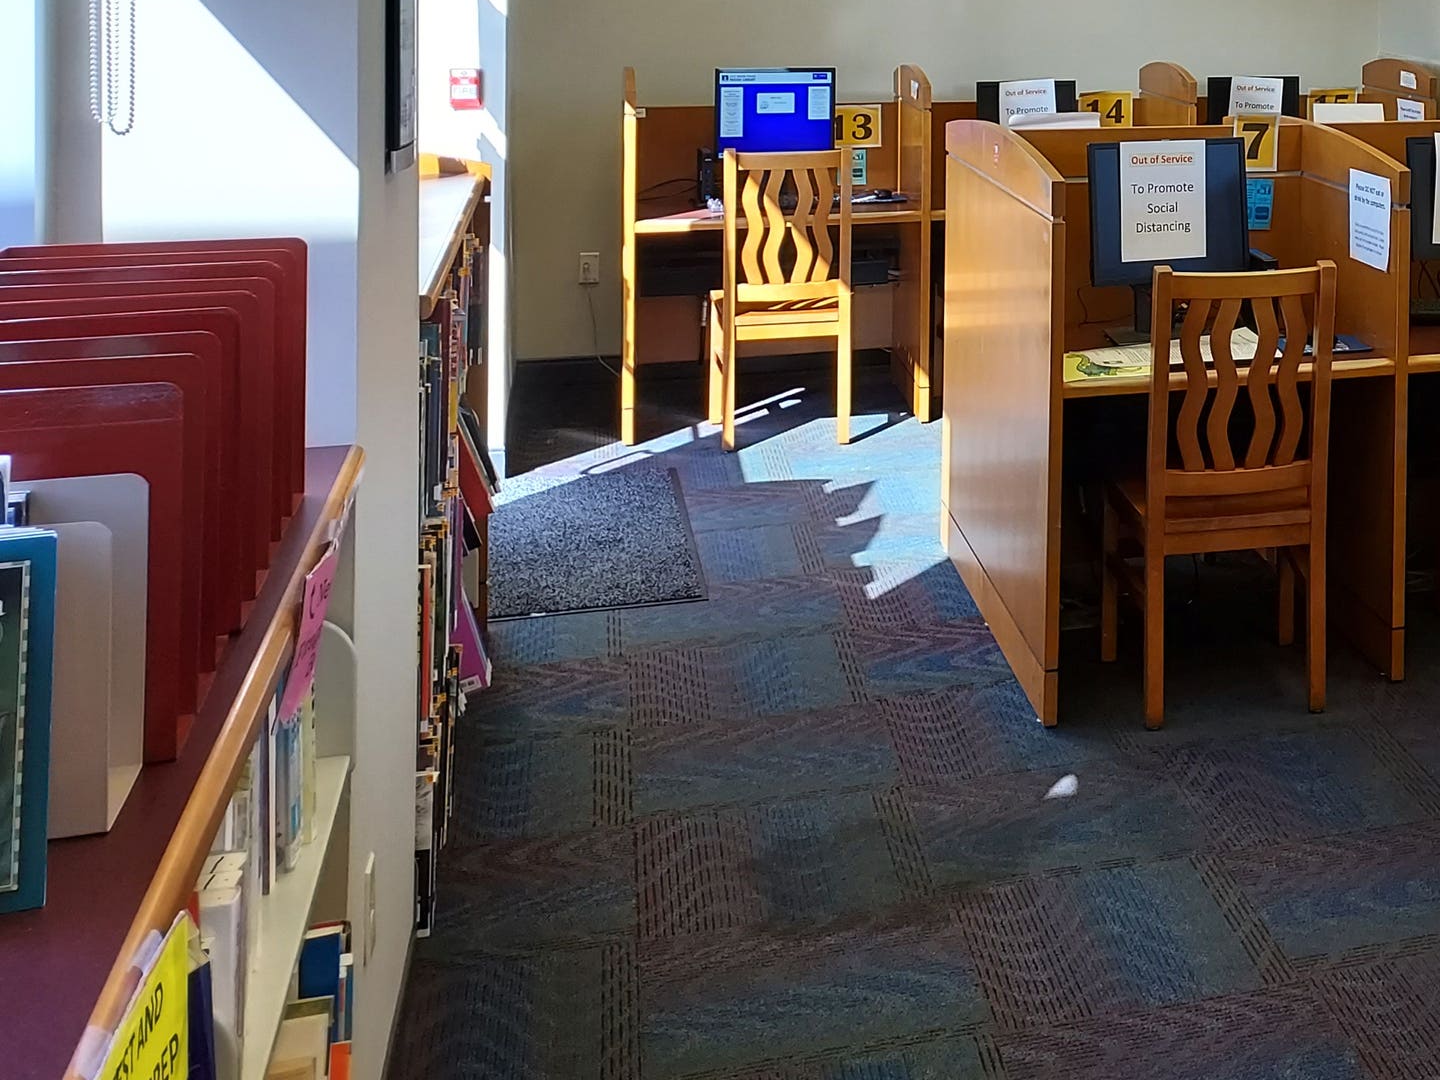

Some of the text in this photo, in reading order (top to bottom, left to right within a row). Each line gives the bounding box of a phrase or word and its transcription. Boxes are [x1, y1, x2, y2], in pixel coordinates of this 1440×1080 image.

[1006, 106, 1049, 116] To Promote
[1086, 99, 1125, 124] 14
[1235, 101, 1275, 110] To Promote
[836, 113, 873, 140] 13
[1242, 123, 1270, 160] 7
[1131, 154, 1193, 165] Out of Service
[1131, 183, 1194, 194] To Promote
[1147, 202, 1178, 214] Social
[1136, 221, 1191, 233] Distancing
[137, 982, 164, 1061] AND
